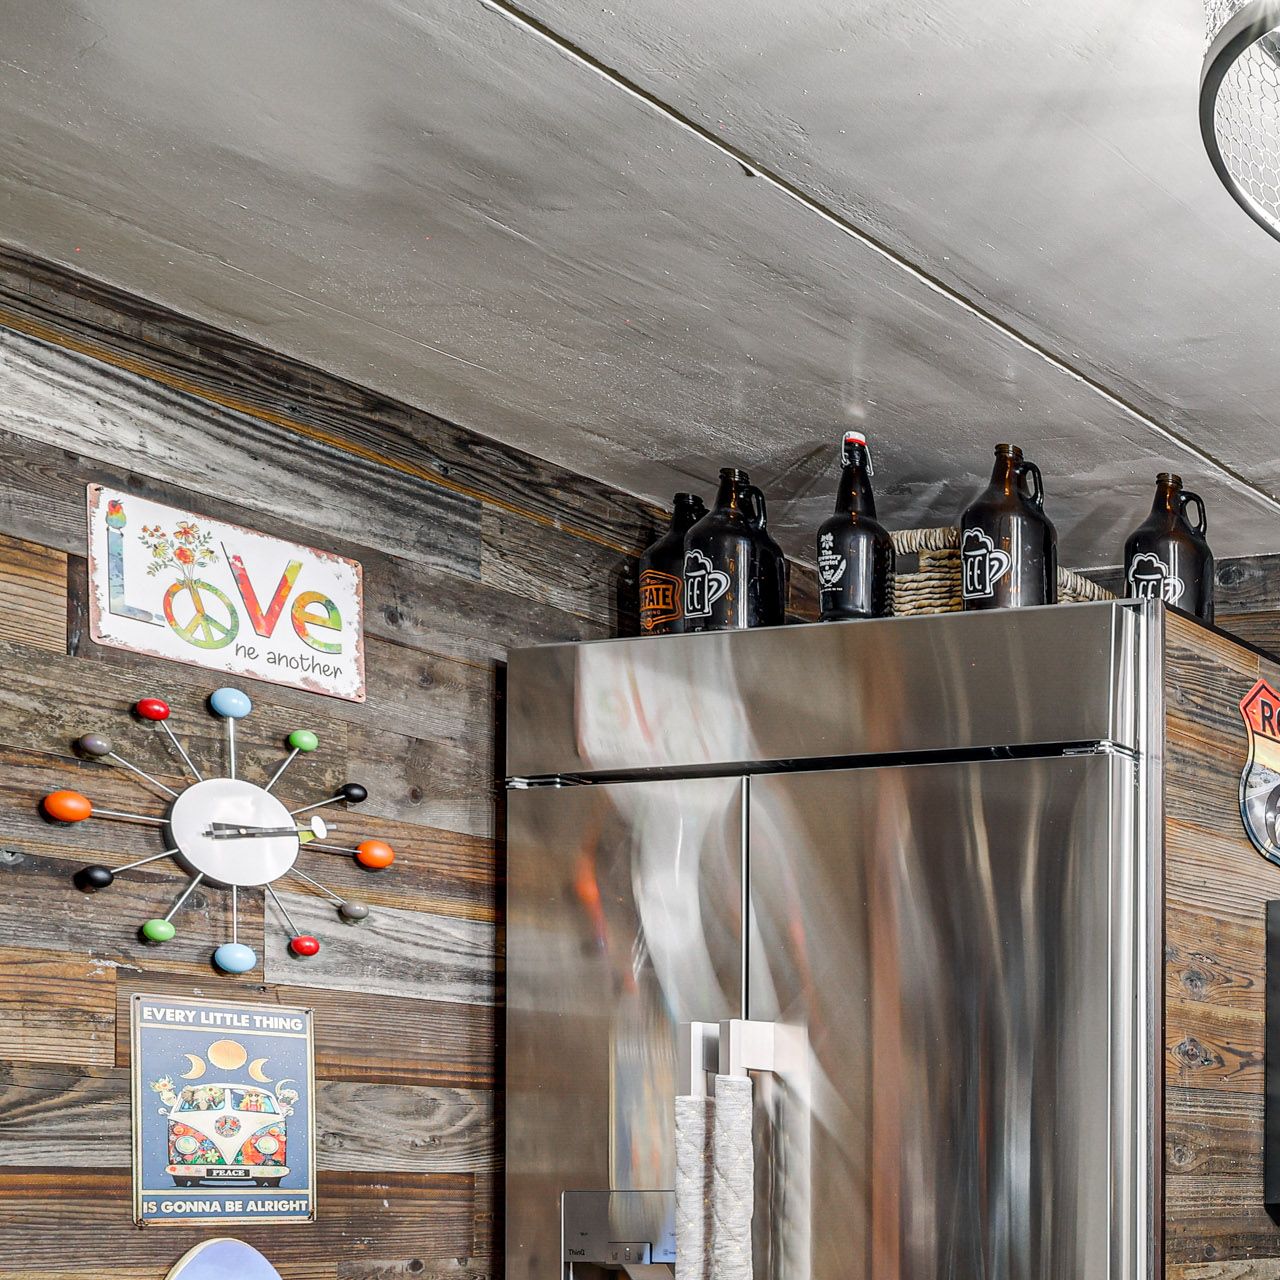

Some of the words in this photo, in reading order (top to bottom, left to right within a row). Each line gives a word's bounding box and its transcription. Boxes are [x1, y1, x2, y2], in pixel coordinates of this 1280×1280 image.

[266, 646, 342, 678] another
[143, 1007, 196, 1023] EVERY
[200, 1011, 249, 1027] LITTLE
[253, 1015, 303, 1031] THING
[211, 1169, 245, 1177] PEACE
[143, 1202, 157, 1214] IS
[161, 1201, 224, 1213] GONNA
[228, 1200, 243, 1212] BE
[246, 1199, 307, 1212] ALRIGHT
